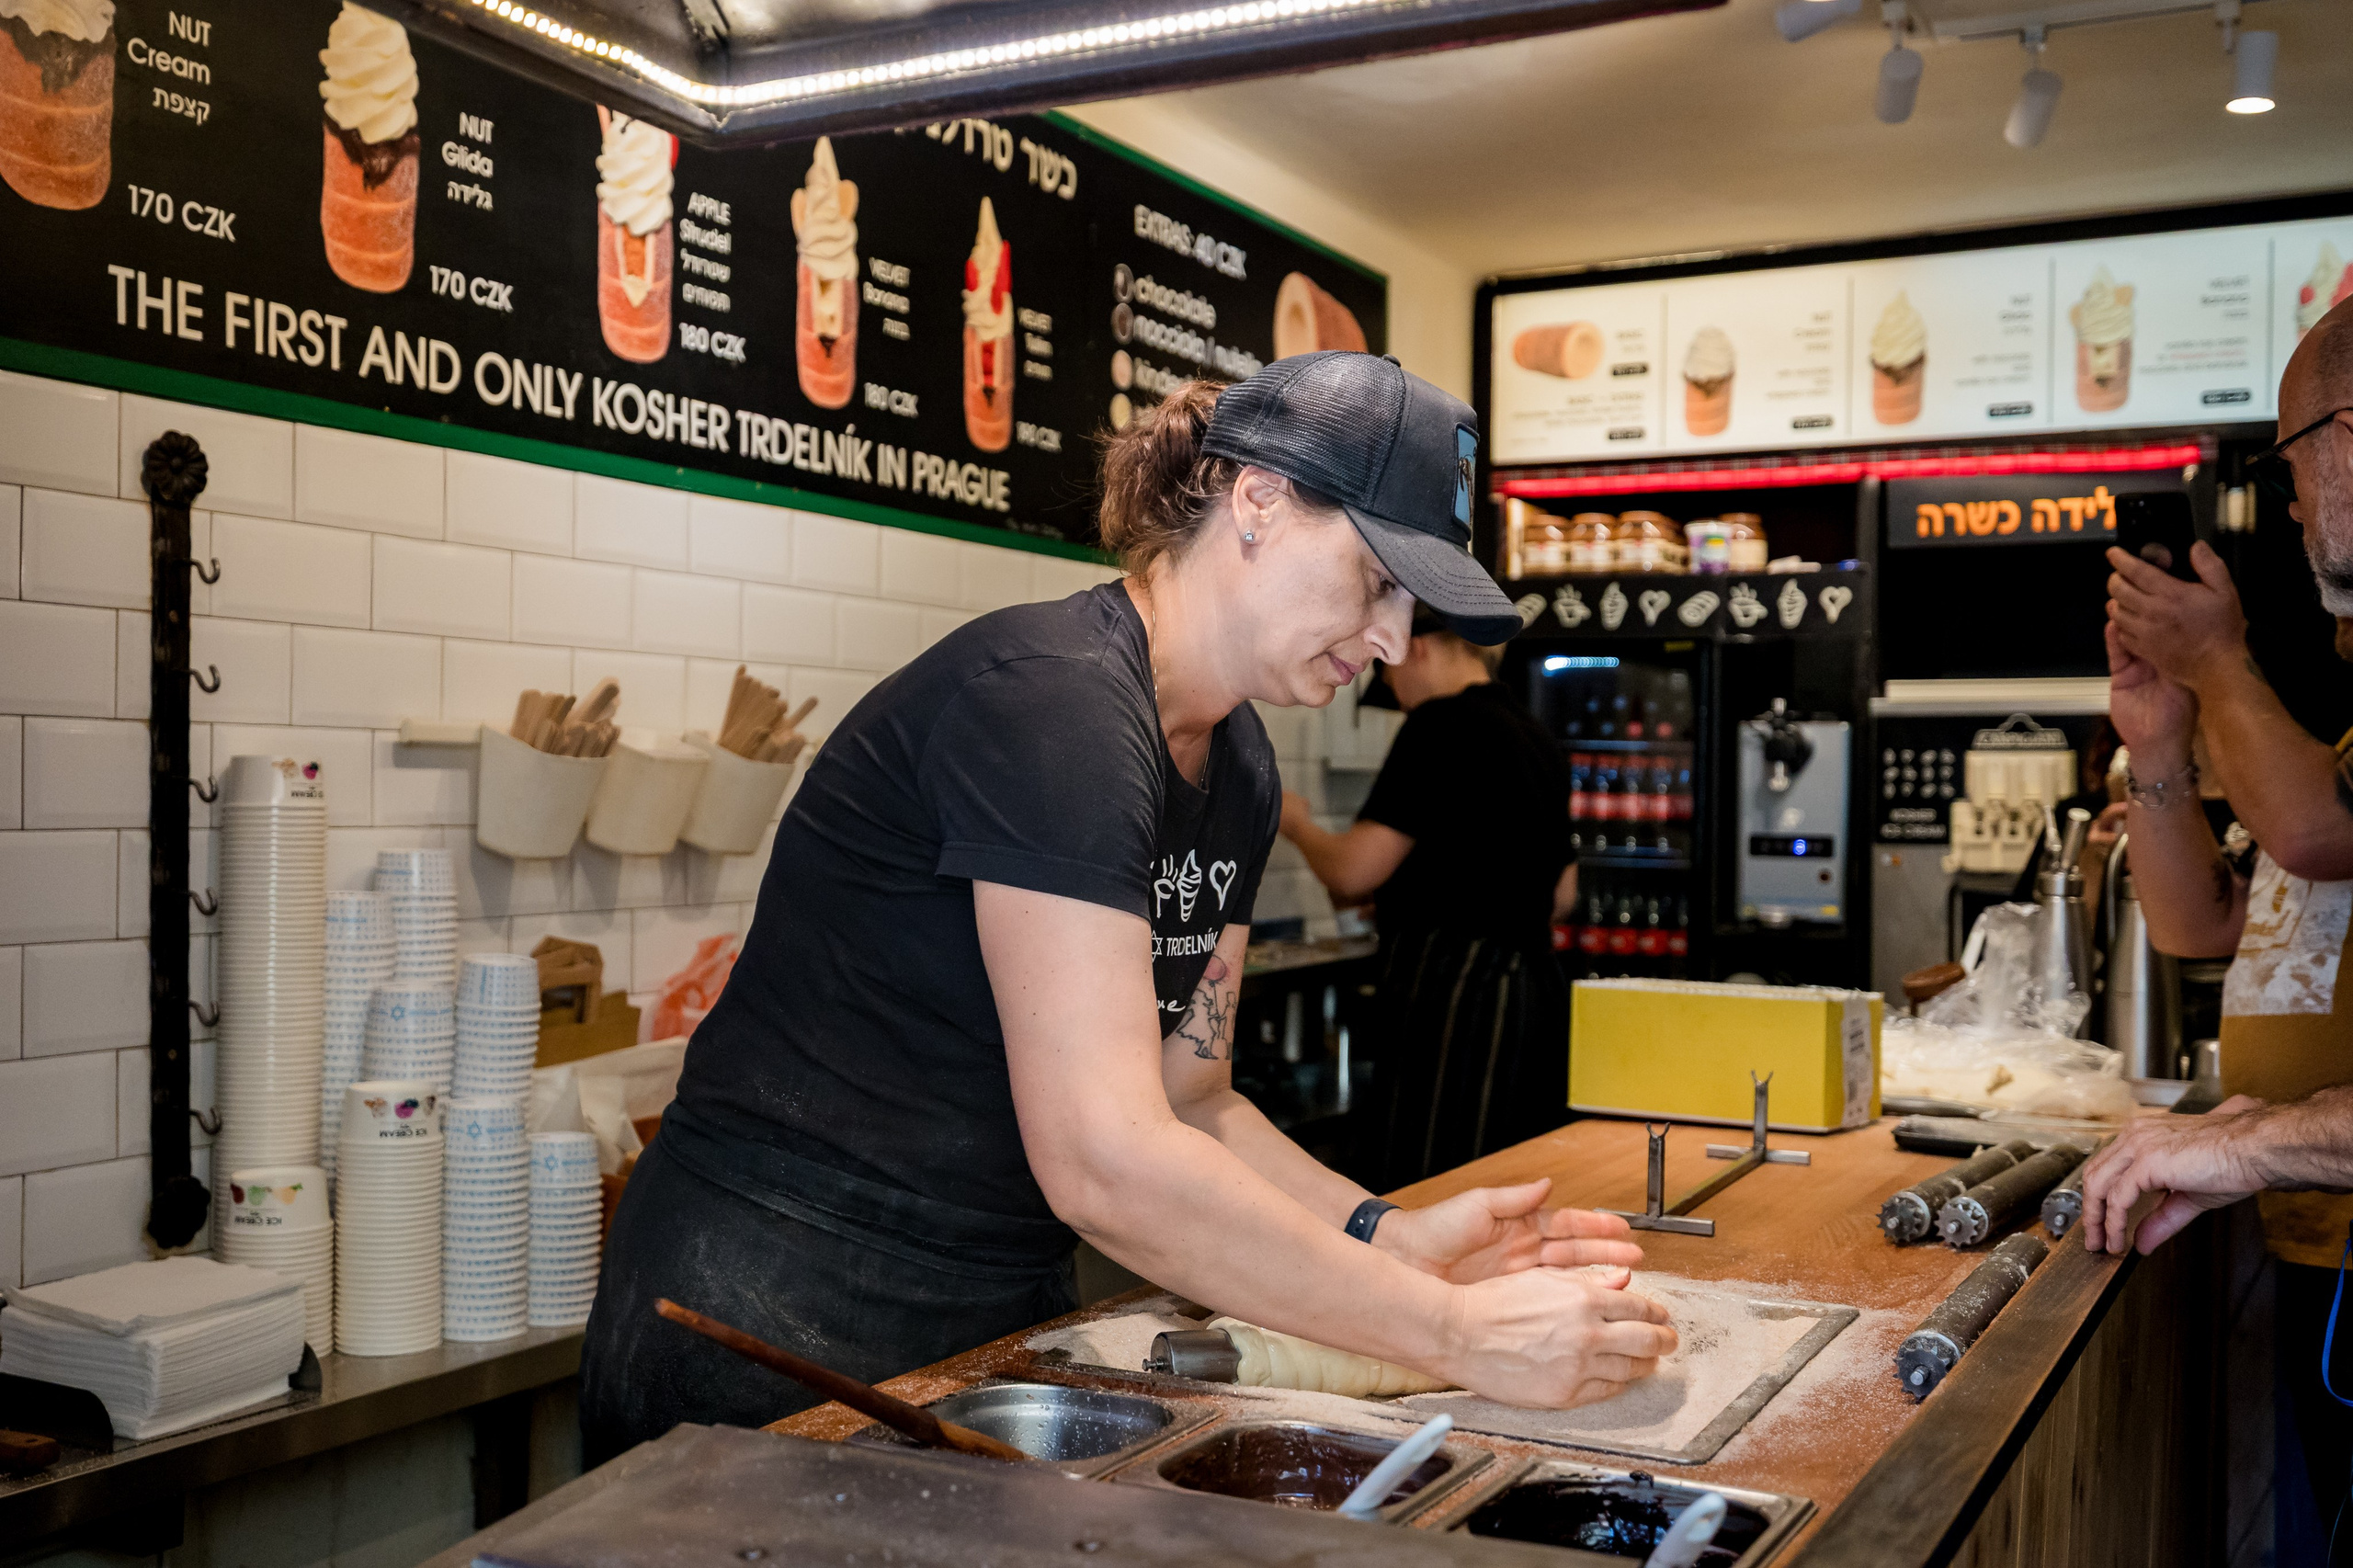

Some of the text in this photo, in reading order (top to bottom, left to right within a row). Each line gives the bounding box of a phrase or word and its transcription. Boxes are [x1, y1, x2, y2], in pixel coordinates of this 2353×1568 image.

[168, 10, 212, 47] NUT
[127, 37, 210, 85] Cream
[152, 86, 210, 126] קצפת
[460, 111, 494, 144] NUT
[441, 141, 494, 178] Glida
[1019, 136, 1078, 200] כשר
[128, 184, 237, 242] 170 CZK
[447, 180, 494, 212] גלידה
[688, 191, 732, 226] APPLE
[679, 218, 732, 256] Strudel
[1215, 242, 1247, 280] CZK
[428, 265, 514, 313] 170 CZK
[678, 322, 746, 363] 180 CZK
[108, 264, 1011, 513] THE FIRST AND ONLY KOSHER TRDELNÍK IN PRAGUE
[889, 390, 919, 419] CZK
[1916, 485, 2117, 538] לידה כשרה
[1166, 927, 1219, 957] TRDELNÍK
[379, 1129, 414, 1139] CREAM
[266, 1216, 282, 1225] ICE
